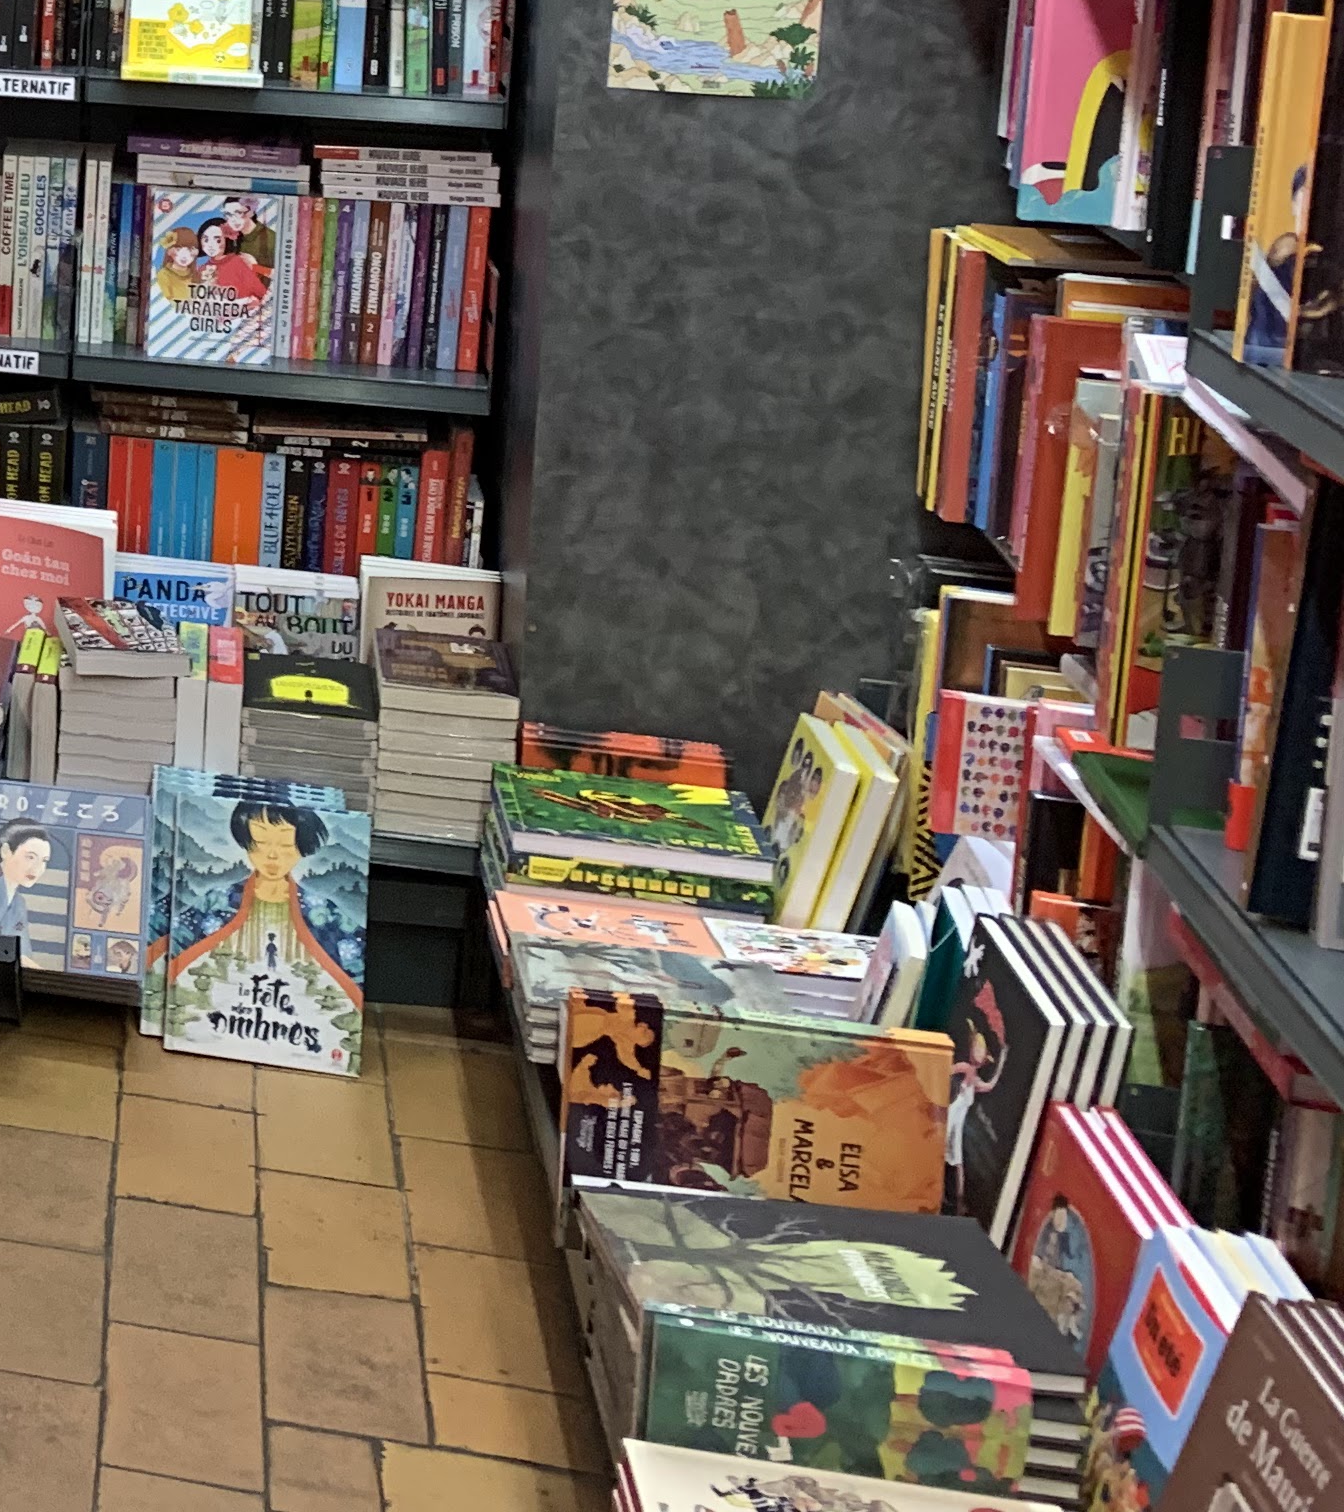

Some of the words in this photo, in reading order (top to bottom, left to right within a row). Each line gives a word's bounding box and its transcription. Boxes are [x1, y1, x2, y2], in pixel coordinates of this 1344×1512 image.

[3, 171, 15, 204] TIME
[20, 173, 31, 203] BLEU
[35, 175, 47, 236] GOGGLES
[1, 207, 14, 255] COFFEE
[18, 205, 30, 267] L'OISEAU
[187, 284, 237, 302] TOKYO
[366, 251, 382, 314] ZENKAMONO
[173, 299, 250, 318] TARAREBA
[189, 316, 232, 334] GIRLS
[0, 400, 31, 414] HEAD
[1, 563, 38, 583] chez
[40, 570, 70, 586] moi
[123, 578, 207, 603] PANDA
[240, 591, 305, 614] TOUT
[386, 591, 430, 608] YOKAI
[435, 594, 485, 611] MANGA
[288, 616, 353, 634] BOUT
[51, 800, 122, 823] こころ
[207, 1007, 322, 1054] ombres
[815, 1154, 830, 1170] &
[837, 1141, 862, 1193] ELISA
[768, 1328, 860, 1357] NOUVEAUX
[744, 1353, 769, 1388] LES
[1259, 1376, 1281, 1419] La
[1226, 1399, 1254, 1446] de
